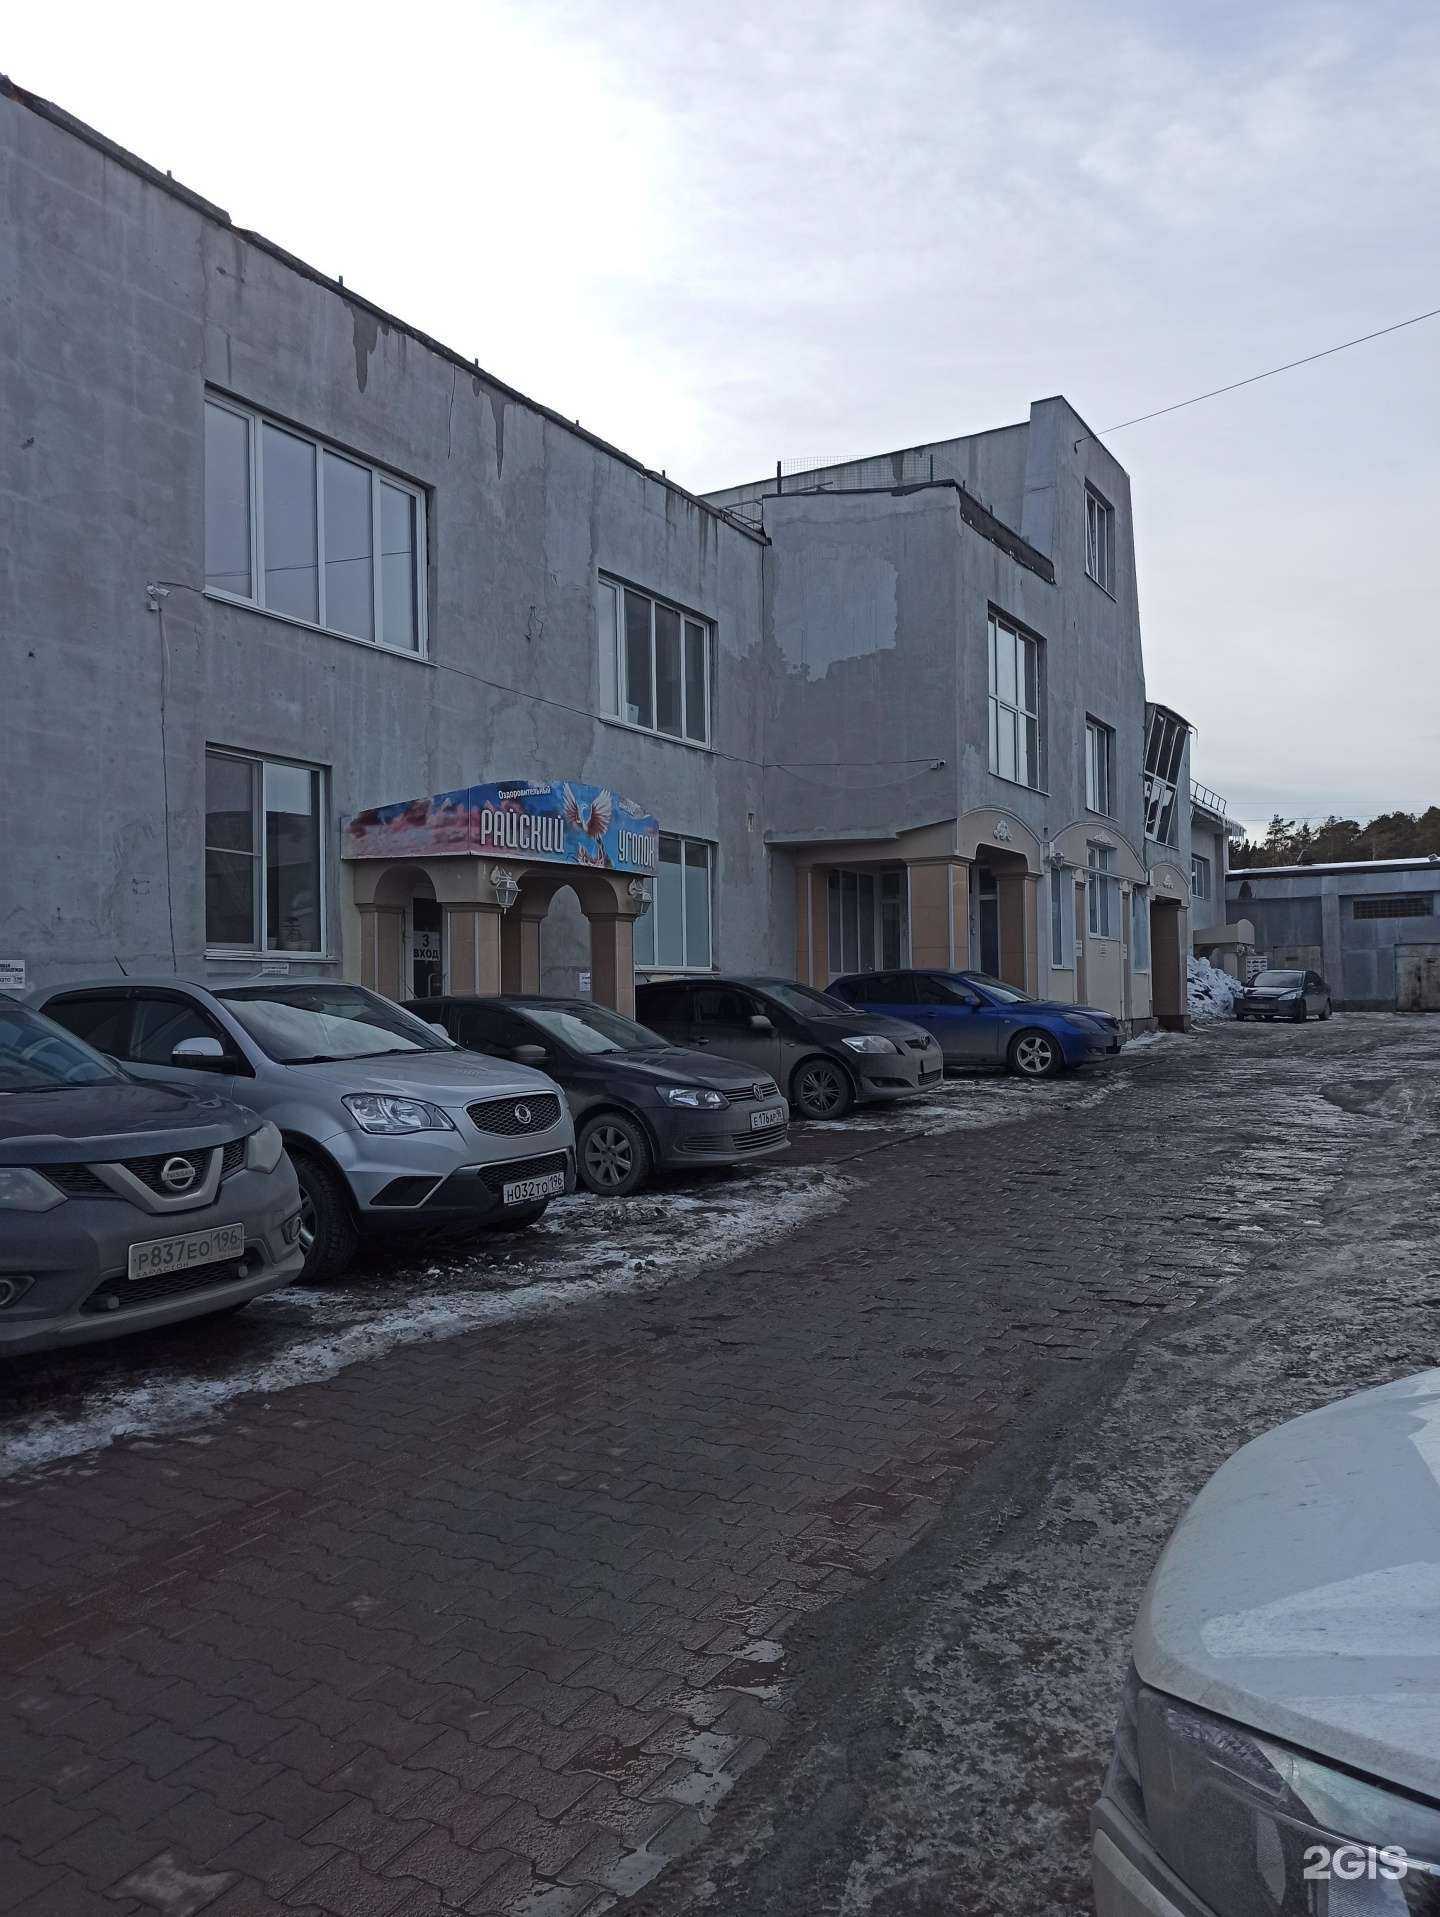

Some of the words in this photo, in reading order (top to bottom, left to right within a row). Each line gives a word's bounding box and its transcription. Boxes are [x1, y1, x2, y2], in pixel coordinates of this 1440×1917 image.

[498, 785, 551, 799] Оздоровительный
[481, 808, 565, 853] РАЙСКИЙ
[618, 830, 656, 867] УГОЛОК
[421, 934, 430, 947] 3
[413, 948, 440, 959] ВХОД
[212, 1230, 239, 1249] 196
